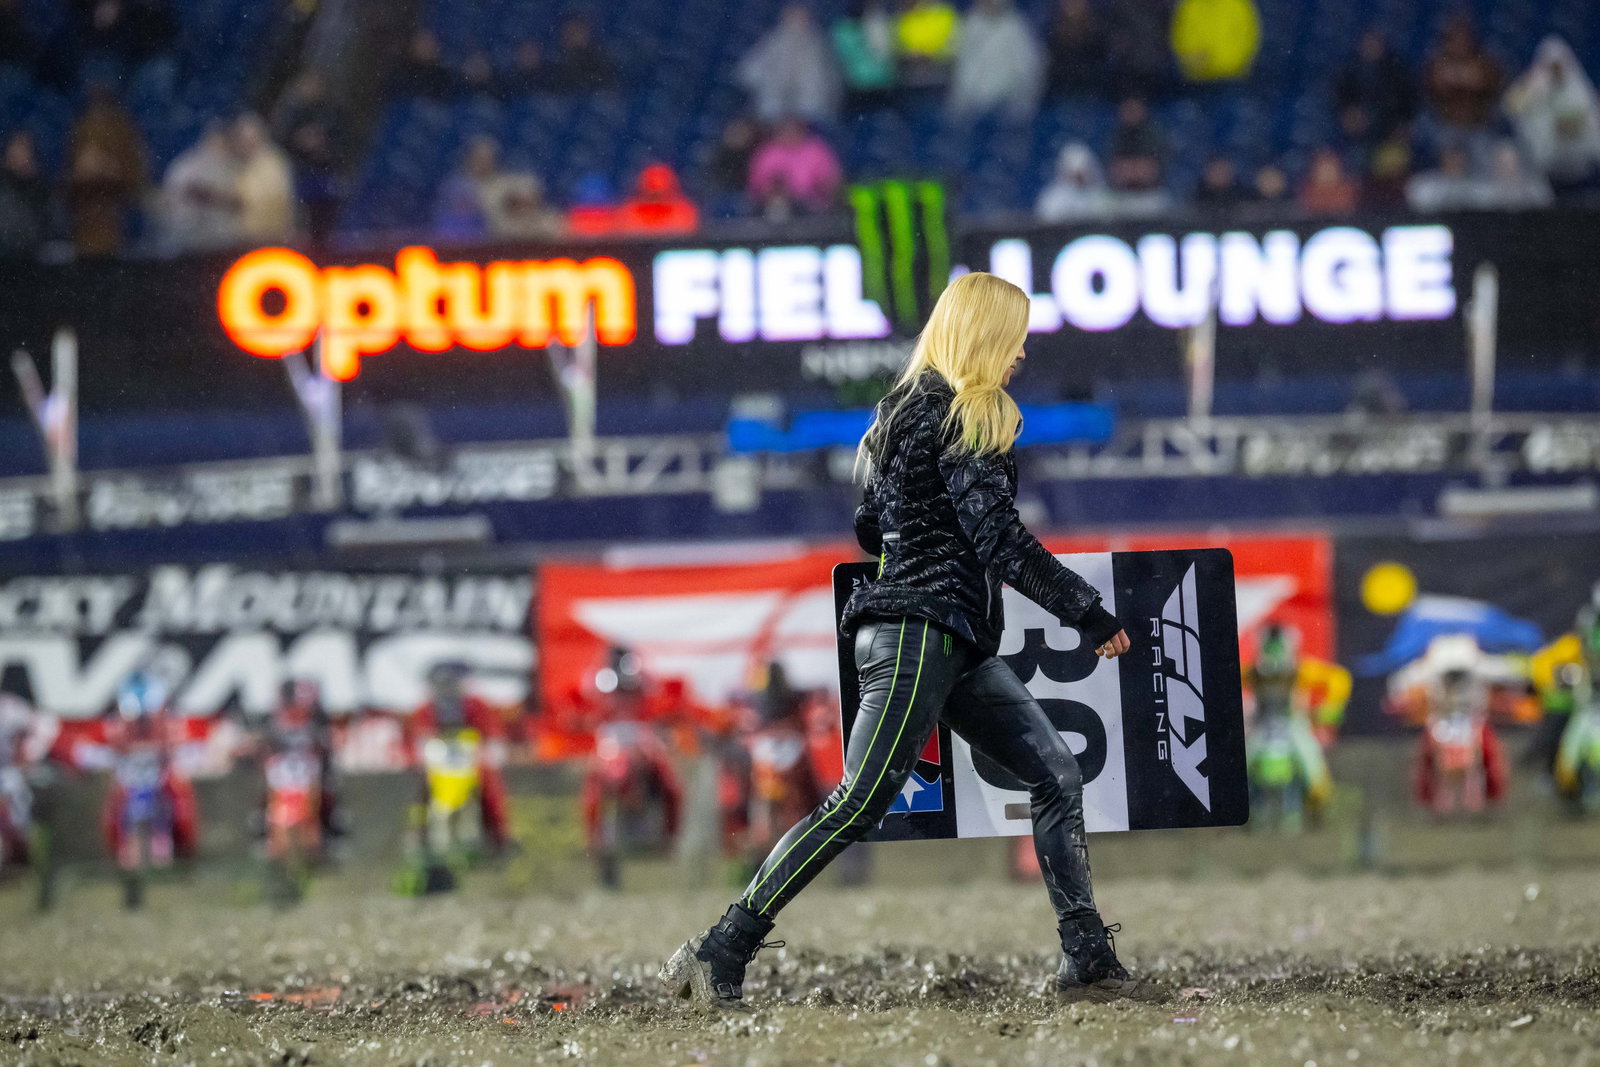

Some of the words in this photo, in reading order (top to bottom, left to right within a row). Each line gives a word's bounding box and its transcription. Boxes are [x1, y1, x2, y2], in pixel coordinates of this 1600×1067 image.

[217, 246, 637, 381] Optum
[651, 245, 970, 345] FIEL
[988, 223, 1457, 335] LOUNGE
[1150, 617, 1168, 761] RACING
[1162, 561, 1210, 812] FLY
